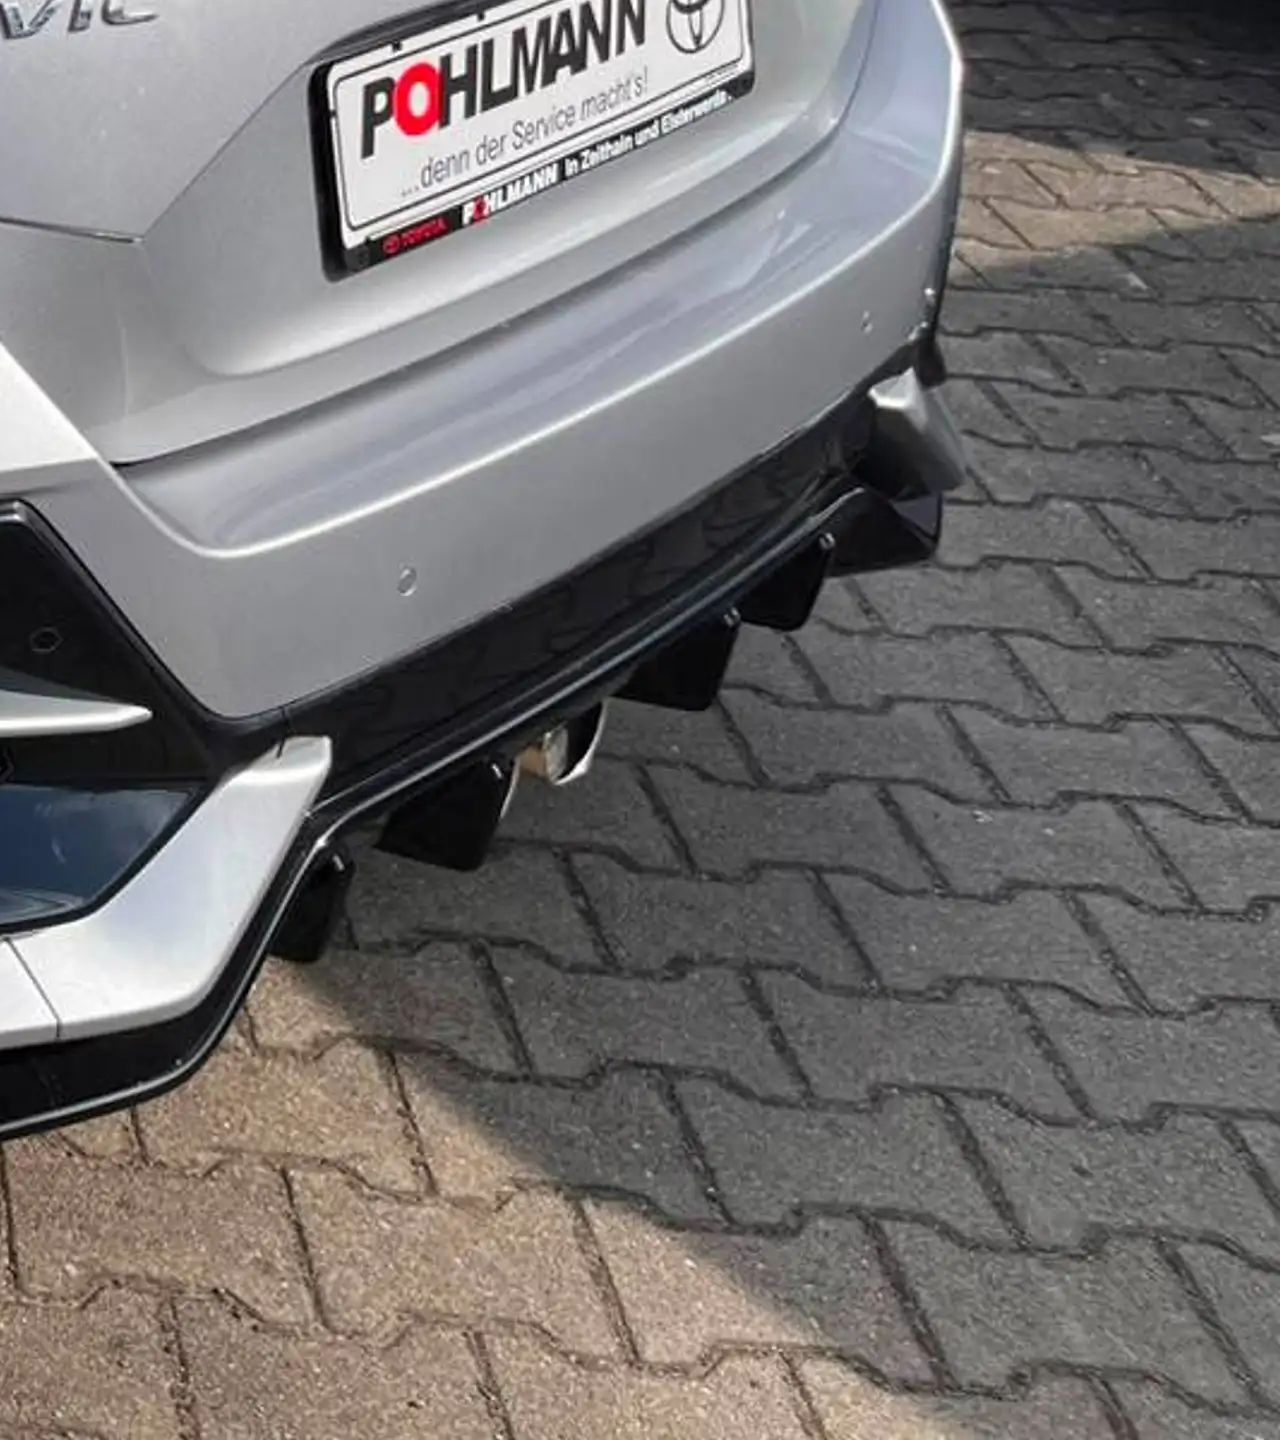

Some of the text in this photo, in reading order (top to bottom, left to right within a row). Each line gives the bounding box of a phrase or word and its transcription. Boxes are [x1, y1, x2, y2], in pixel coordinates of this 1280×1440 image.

[475, 136, 507, 166] der
[511, 106, 576, 152] Service
[579, 66, 648, 119] macht's!
[462, 163, 559, 226] POHLMANN
[634, 118, 660, 146] und
